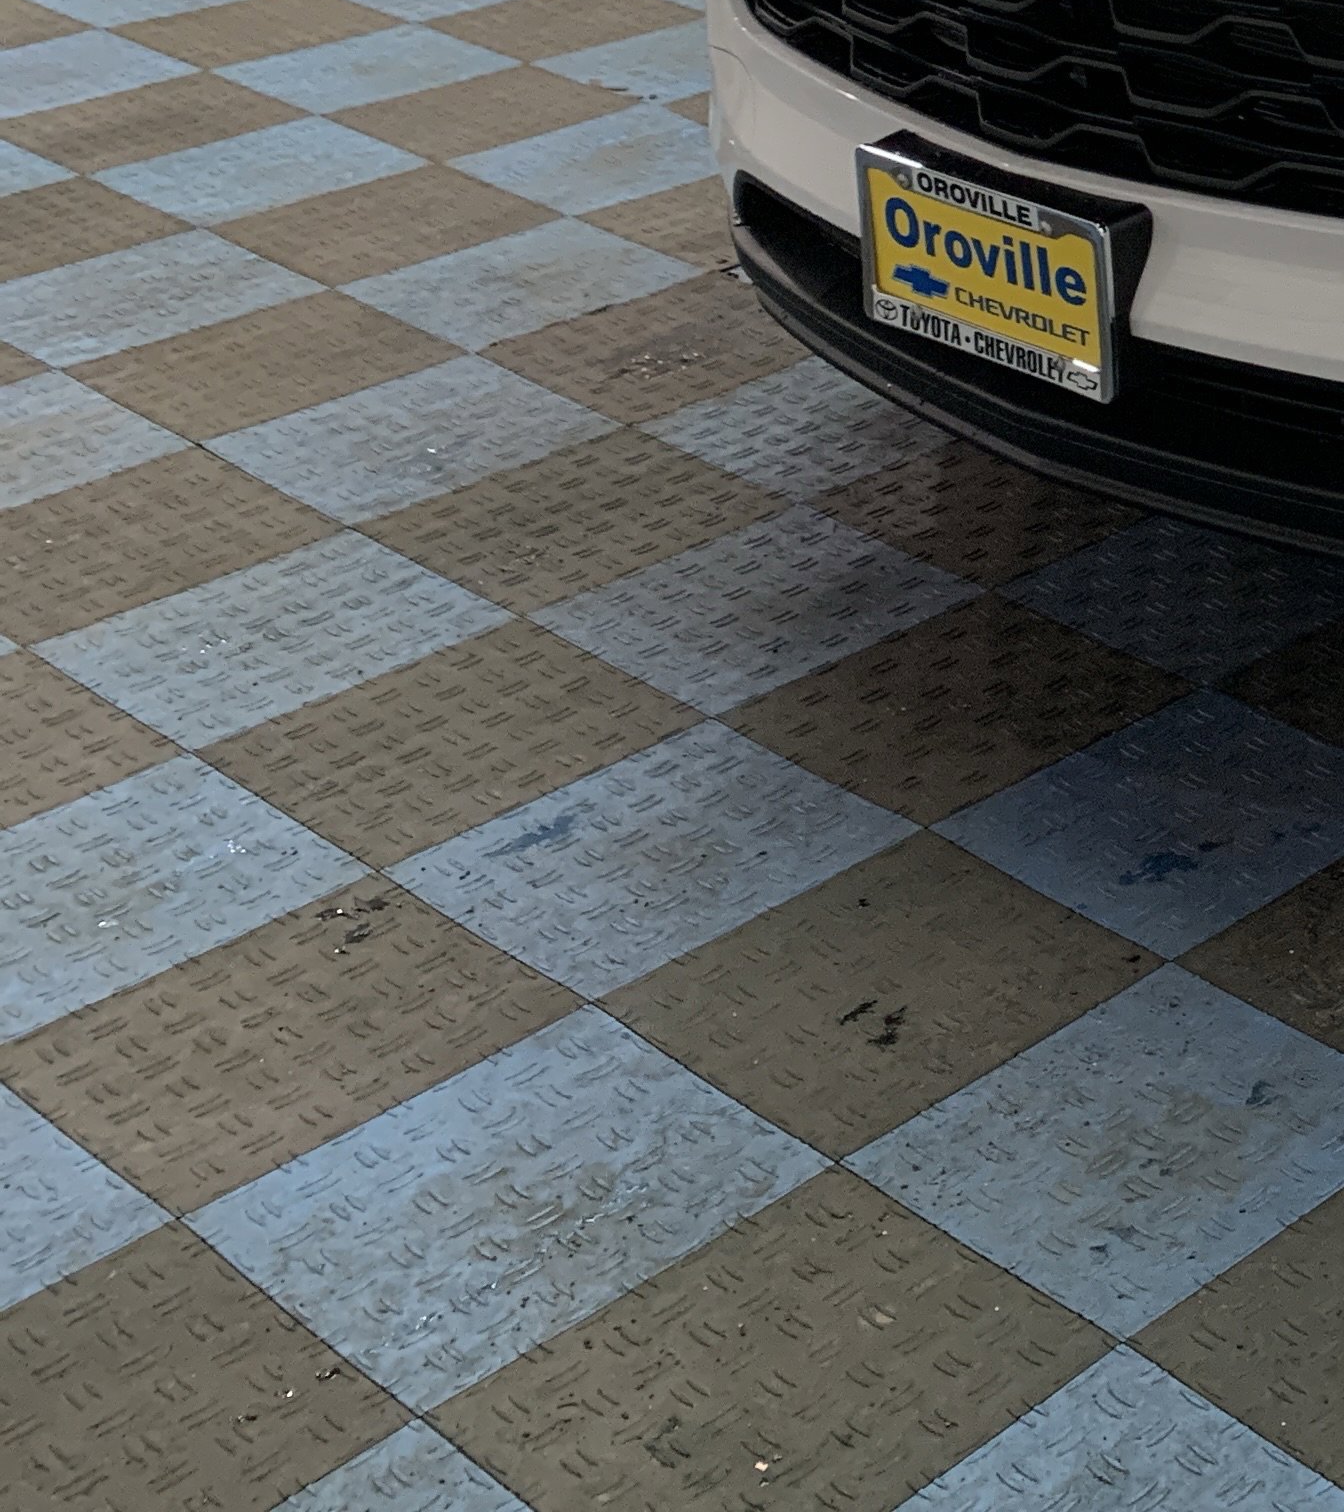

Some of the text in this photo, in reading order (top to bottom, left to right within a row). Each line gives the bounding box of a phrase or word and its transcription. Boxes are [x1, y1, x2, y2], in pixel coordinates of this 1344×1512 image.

[917, 172, 1032, 226] OROVILLE
[885, 197, 1086, 306] Oroville
[955, 287, 1090, 346] CHEVROLET
